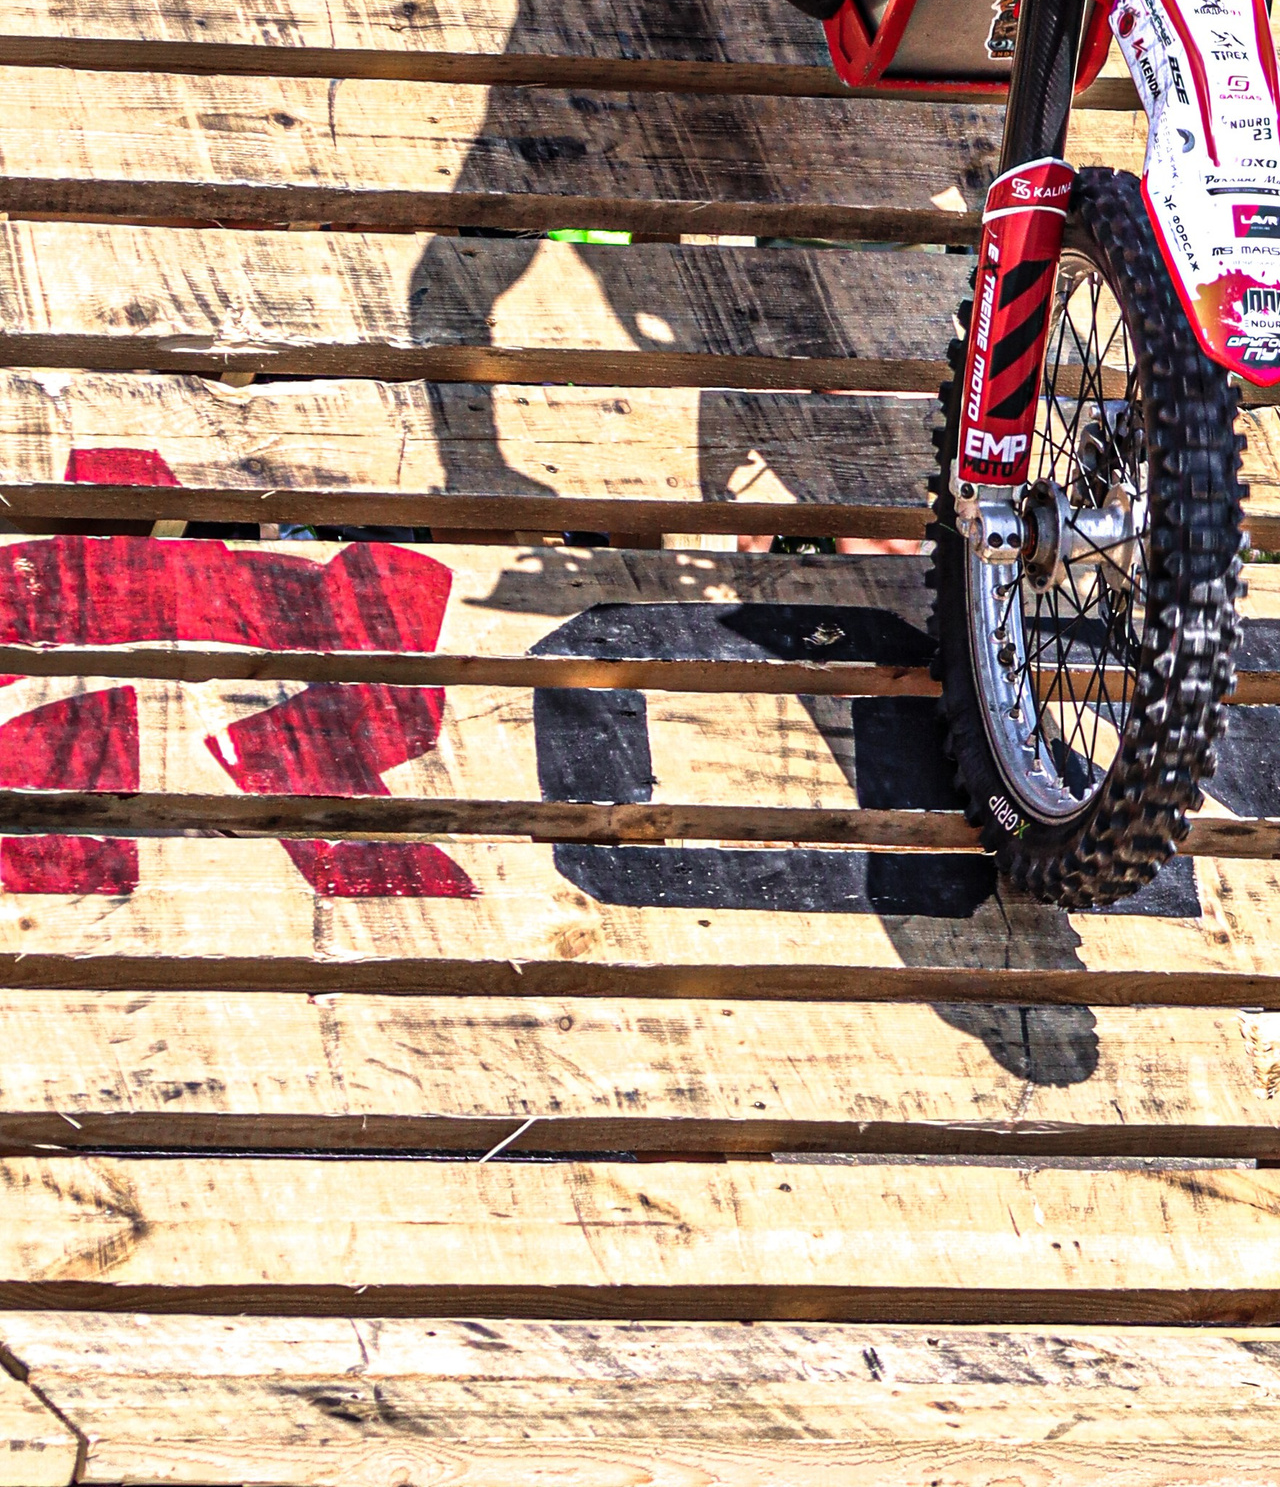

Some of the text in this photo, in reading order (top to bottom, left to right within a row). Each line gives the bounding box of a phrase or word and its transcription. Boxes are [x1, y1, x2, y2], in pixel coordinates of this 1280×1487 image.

[1140, 57, 1161, 99] KENDA
[1168, 55, 1190, 105] BSE
[1253, 127, 1272, 141] 23
[1172, 215, 1200, 272] ФОРСАЖ
[968, 241, 1000, 422] EXTREME MOTO
[964, 427, 1028, 463] EMP
[963, 459, 1013, 478] MOTO
